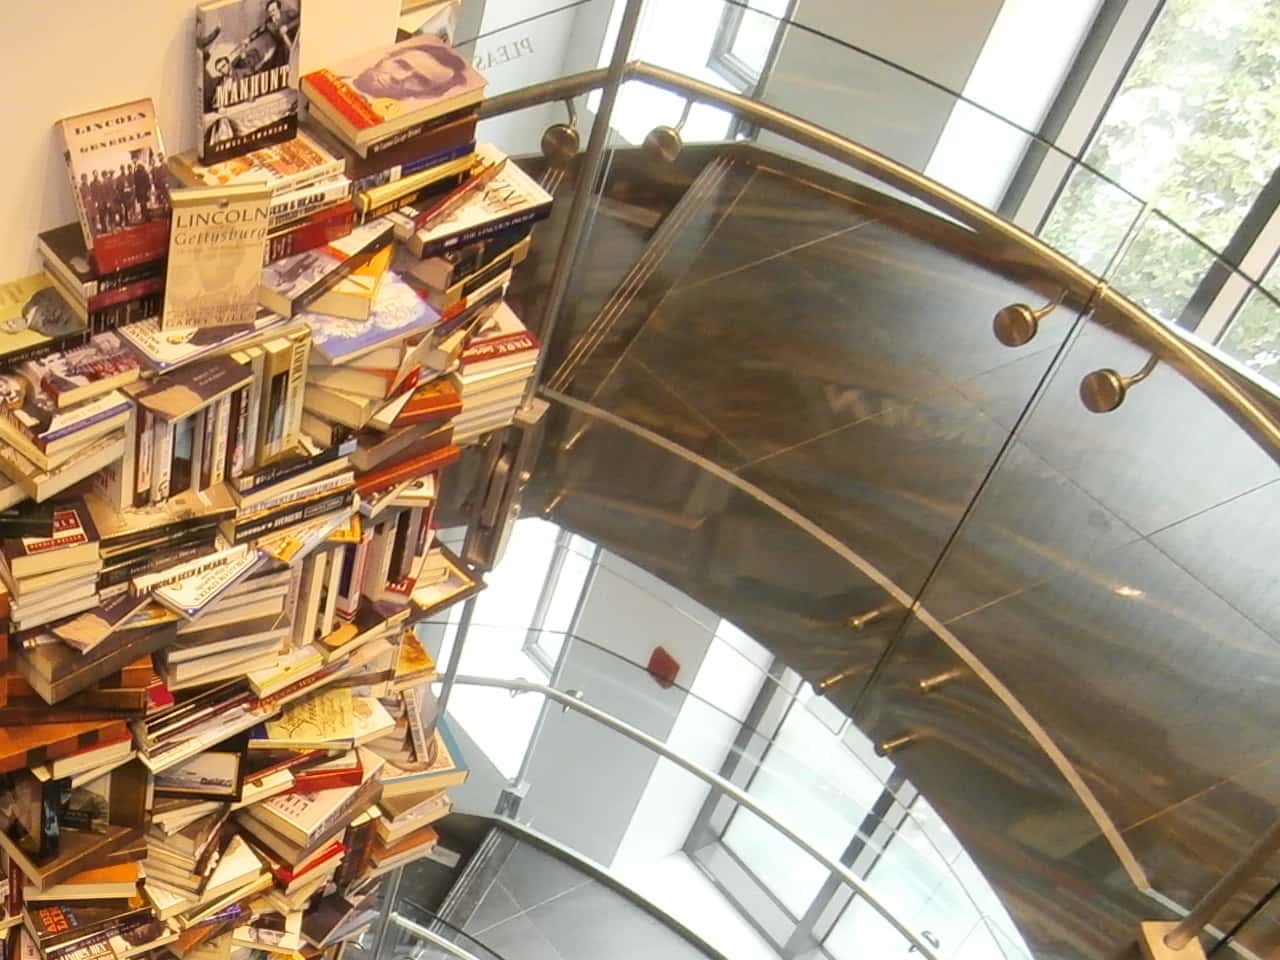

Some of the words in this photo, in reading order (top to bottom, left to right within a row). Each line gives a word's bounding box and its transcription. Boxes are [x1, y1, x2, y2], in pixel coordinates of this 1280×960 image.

[216, 66, 289, 108] MANHUNT
[75, 112, 147, 135] LINCOLN
[80, 131, 152, 153] GENERALS
[176, 208, 269, 228] LINCOLN
[174, 226, 266, 246] Gettysburg
